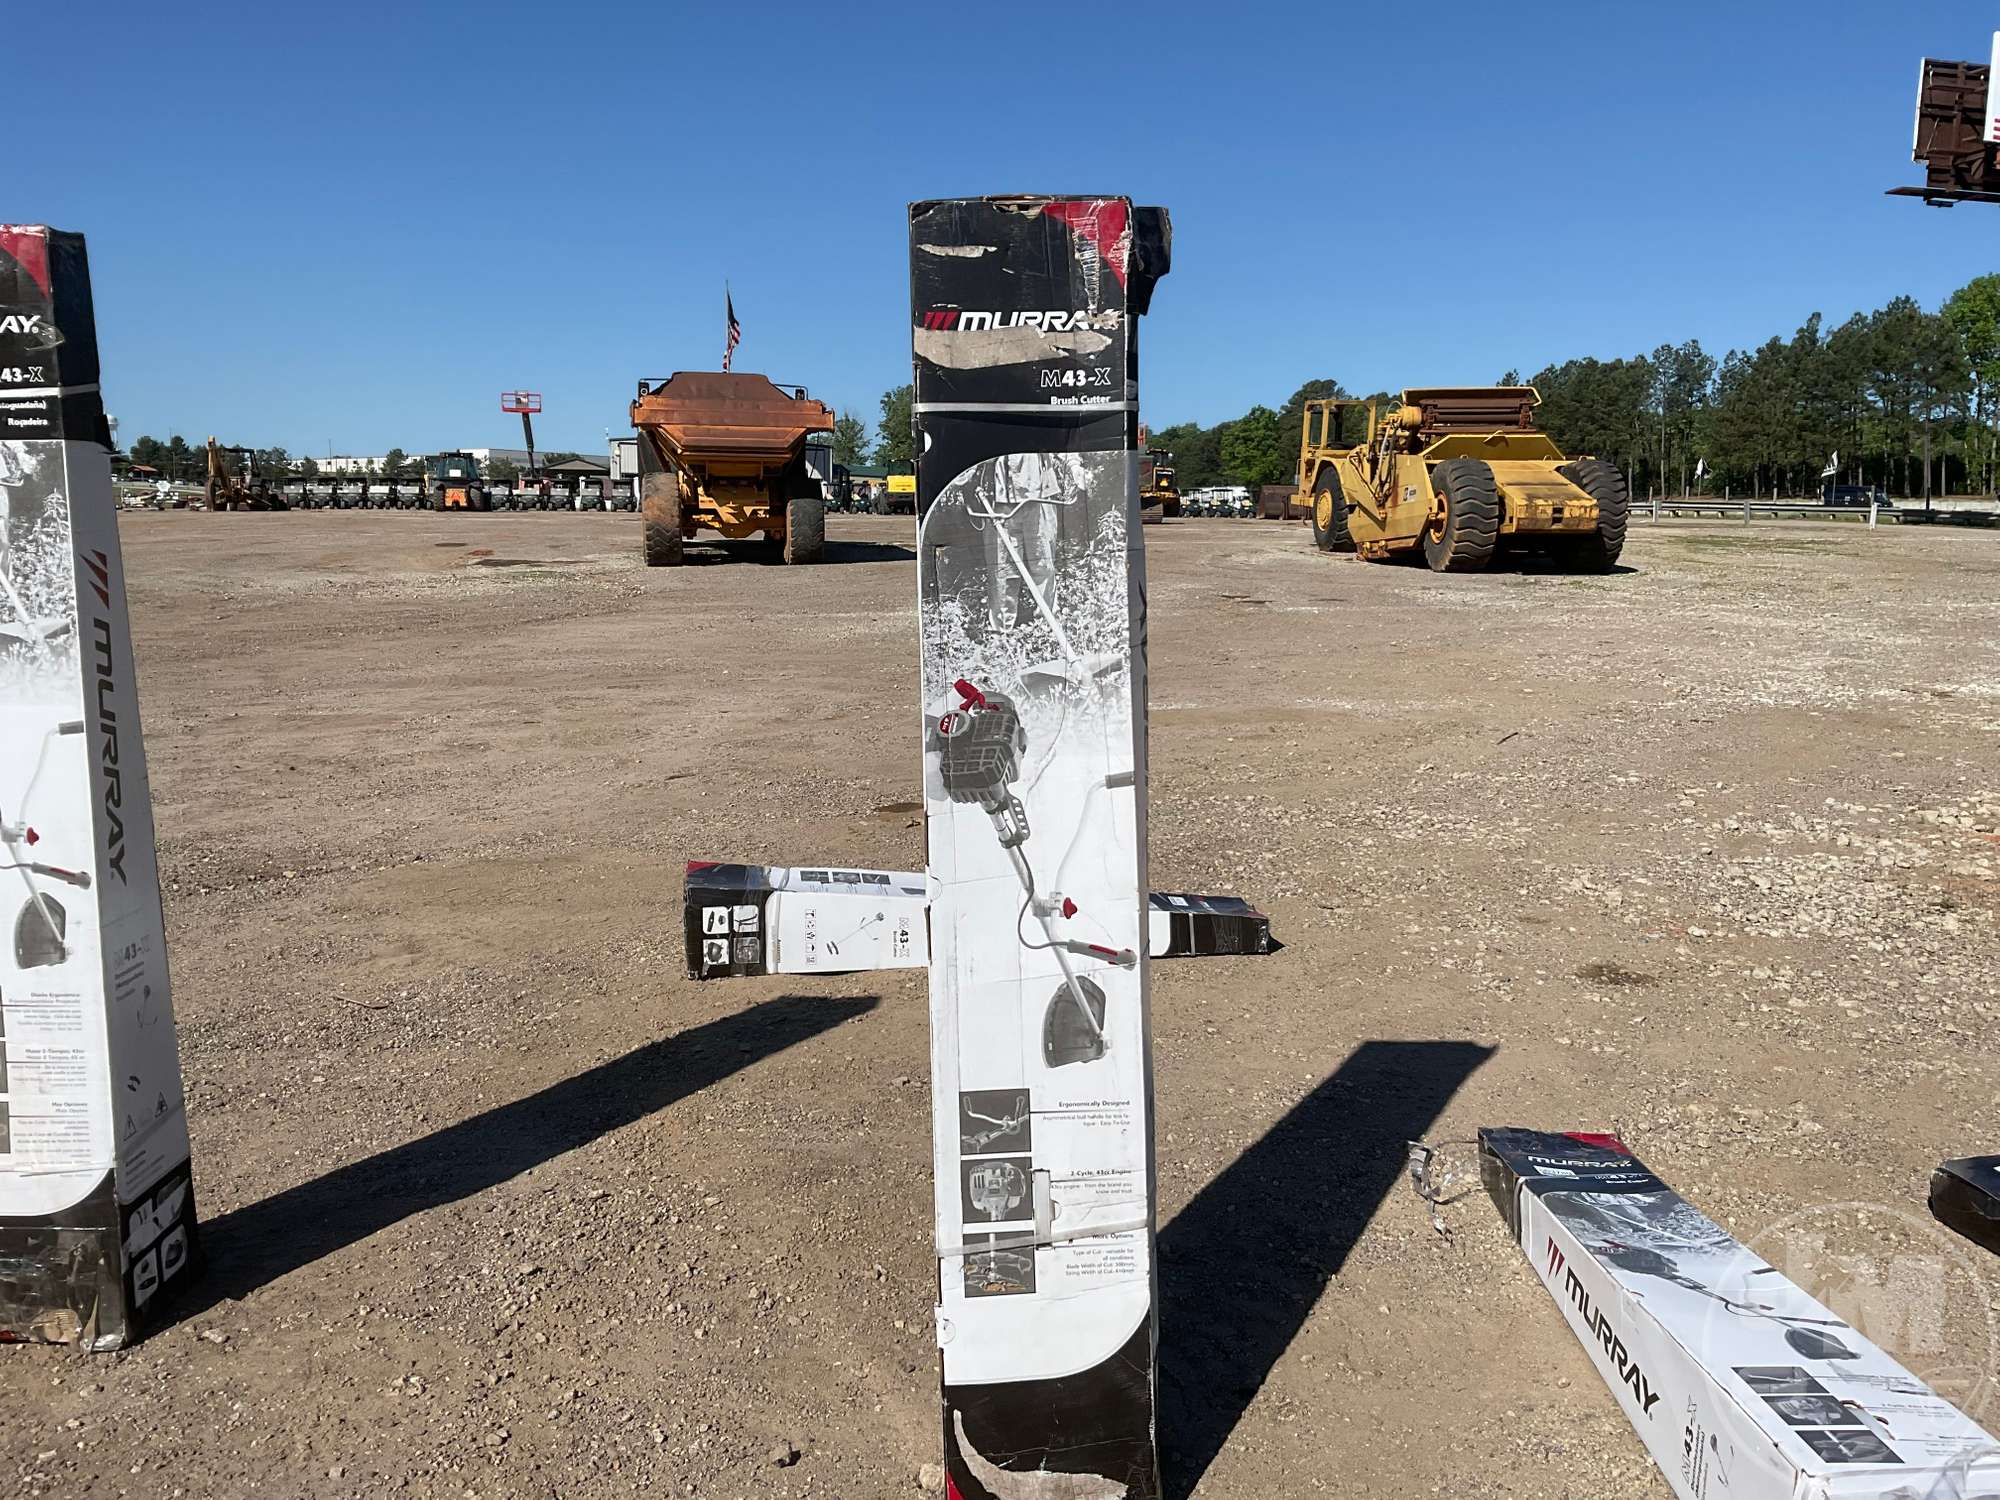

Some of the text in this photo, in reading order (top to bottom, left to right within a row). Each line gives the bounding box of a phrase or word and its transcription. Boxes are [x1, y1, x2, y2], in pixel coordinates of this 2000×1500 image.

[0, 367, 44, 382] 43-X
[1040, 367, 1111, 387] M43-X
[1051, 394, 1111, 405] Brush Cutter
[93, 616, 127, 888] MURRAY
[1059, 1100, 1100, 1108] Ergonomically
[1565, 1266, 1660, 1415] MURRAY
